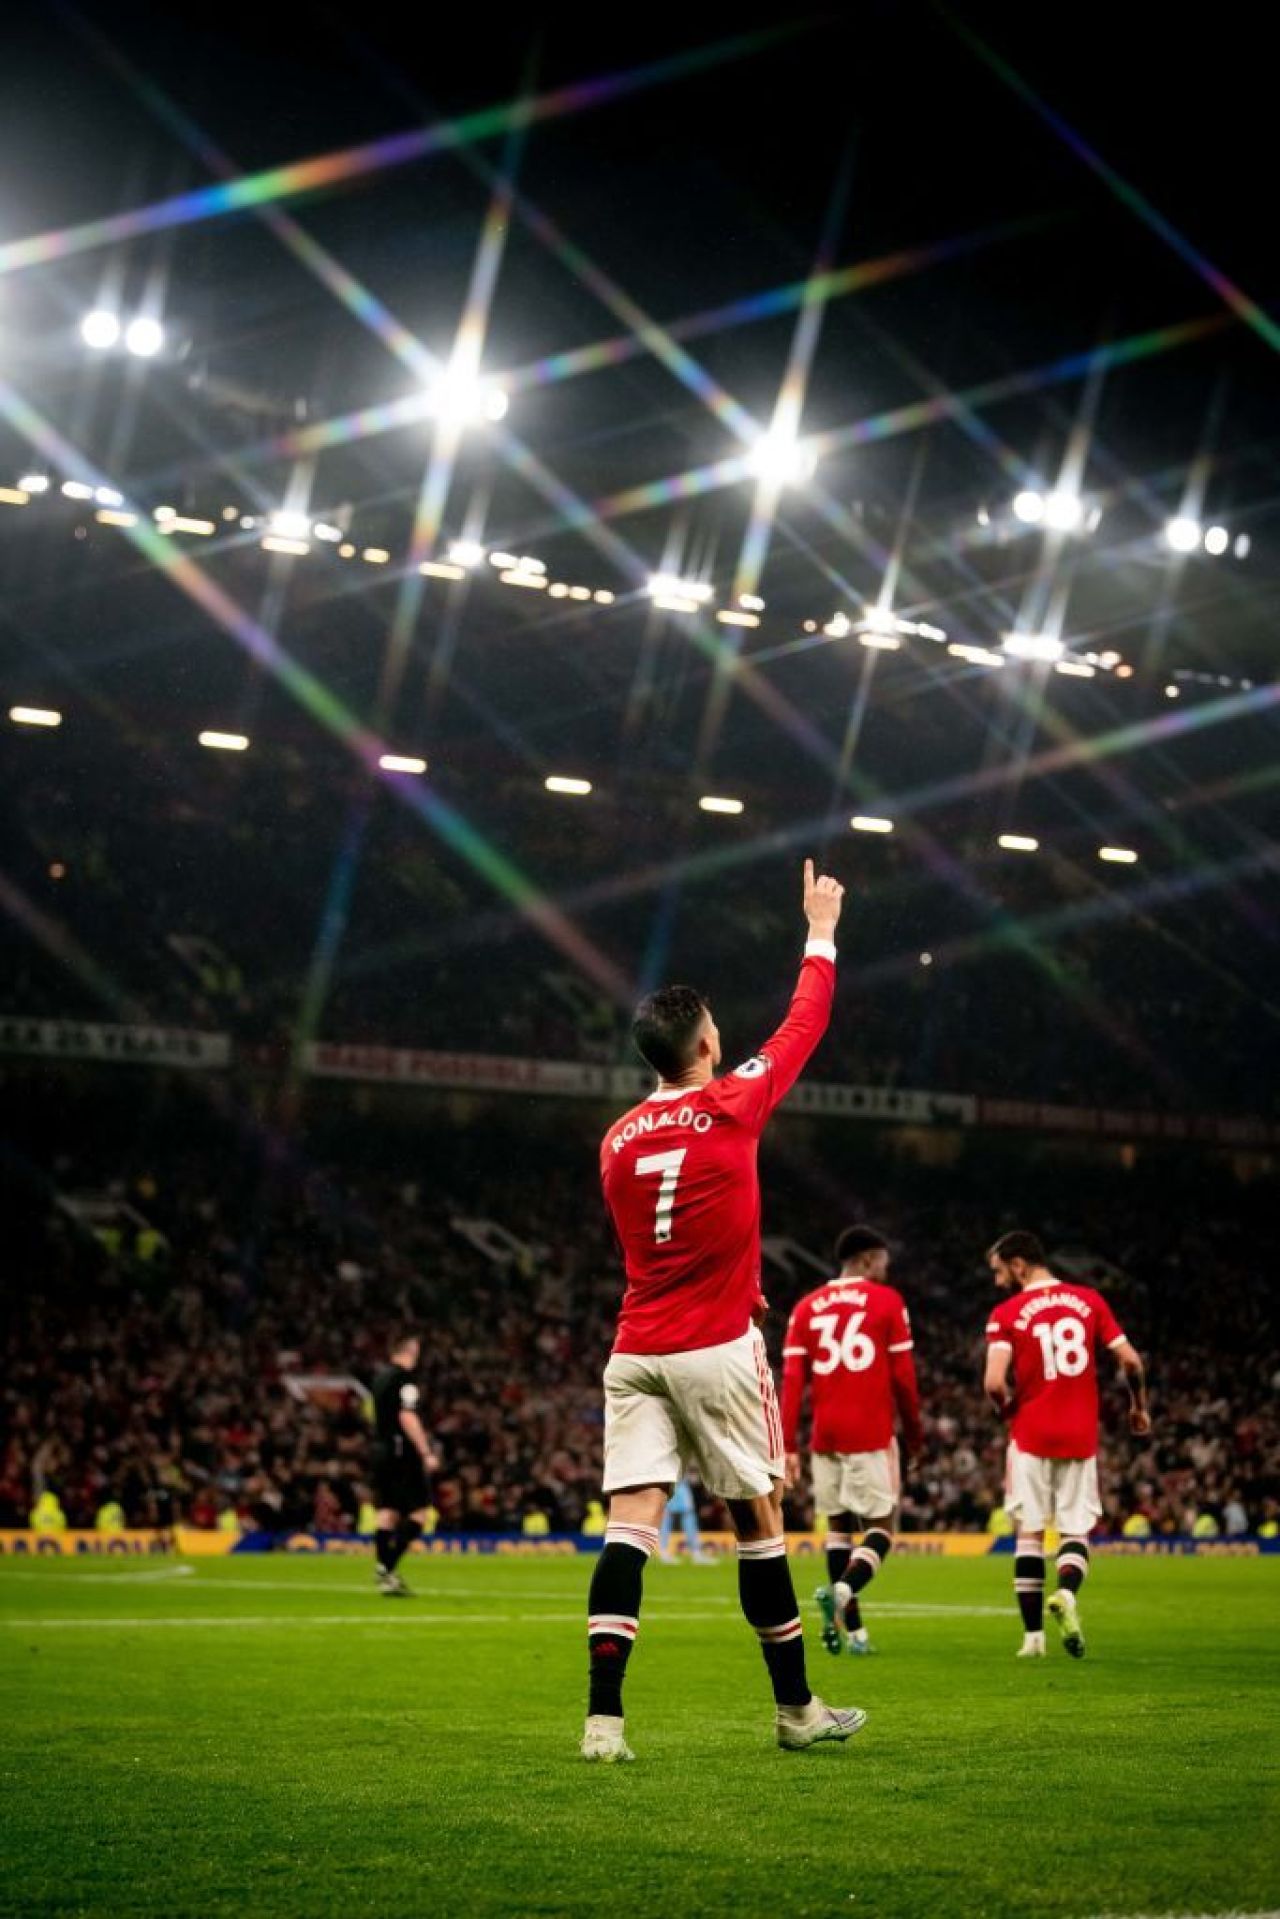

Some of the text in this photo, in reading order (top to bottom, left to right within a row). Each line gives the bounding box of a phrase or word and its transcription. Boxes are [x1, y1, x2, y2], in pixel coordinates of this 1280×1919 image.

[611, 1106, 713, 1153] RONALDO
[634, 1148, 687, 1245] 7
[809, 1312, 876, 1375] 36
[1032, 1316, 1089, 1380] 18
